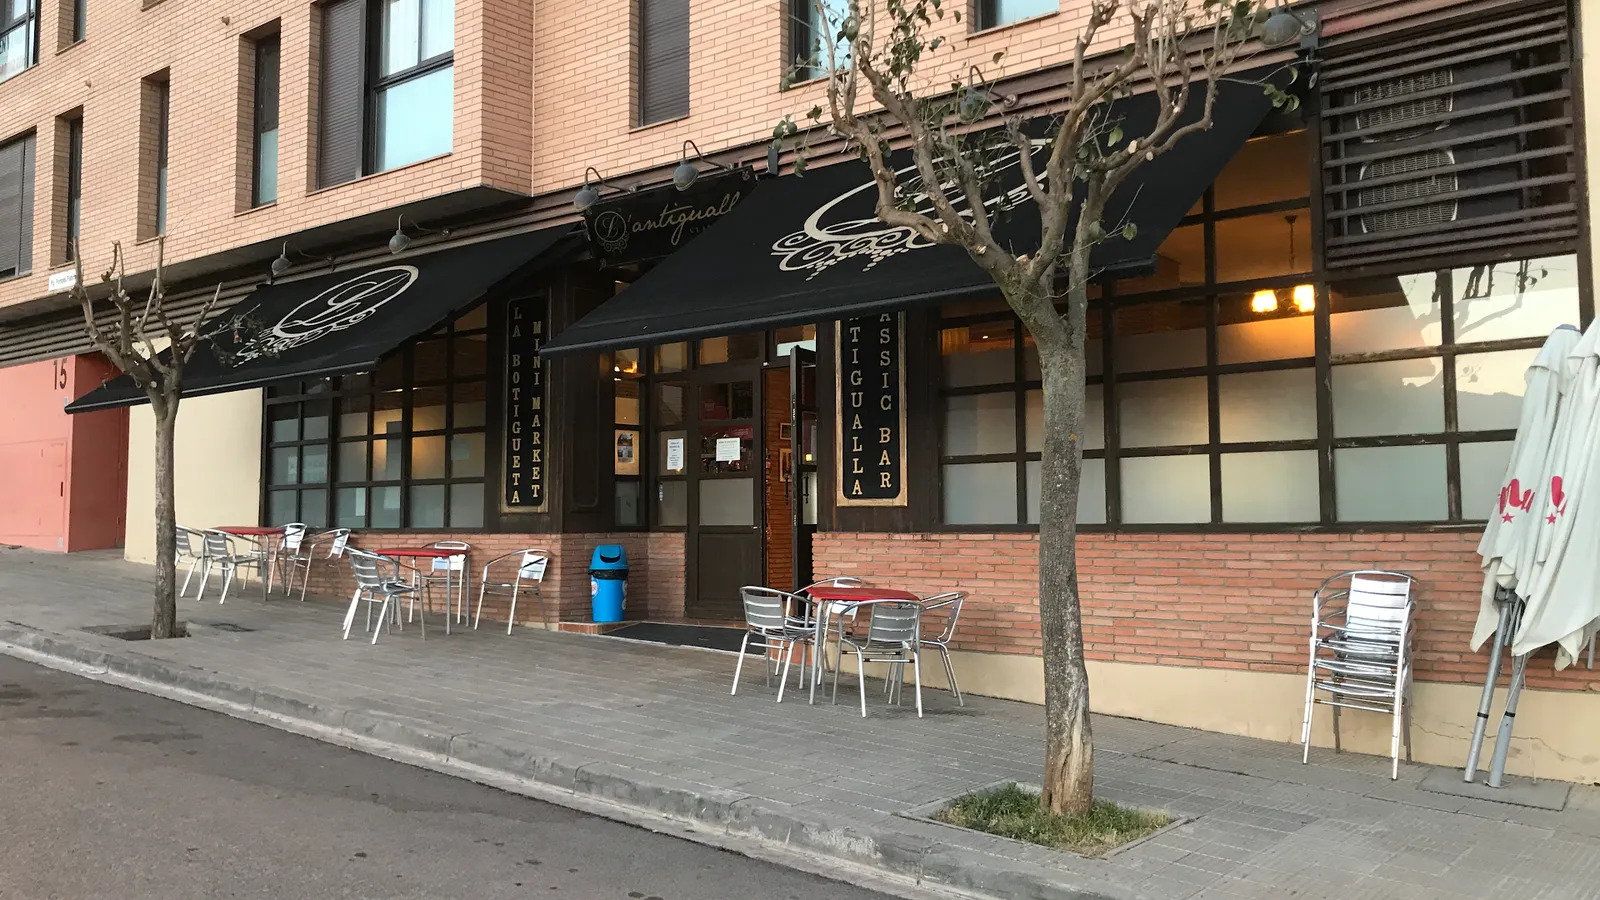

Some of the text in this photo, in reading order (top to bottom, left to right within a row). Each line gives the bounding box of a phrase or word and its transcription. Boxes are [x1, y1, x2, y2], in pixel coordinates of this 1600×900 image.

[600, 191, 740, 246] L'antiguall
[53, 358, 67, 390] 15
[511, 307, 522, 503] LA BOTIGUETA
[532, 321, 542, 498] MINI MARKET
[849, 317, 864, 495] TIGUALLA
[879, 427, 892, 488] BAR
